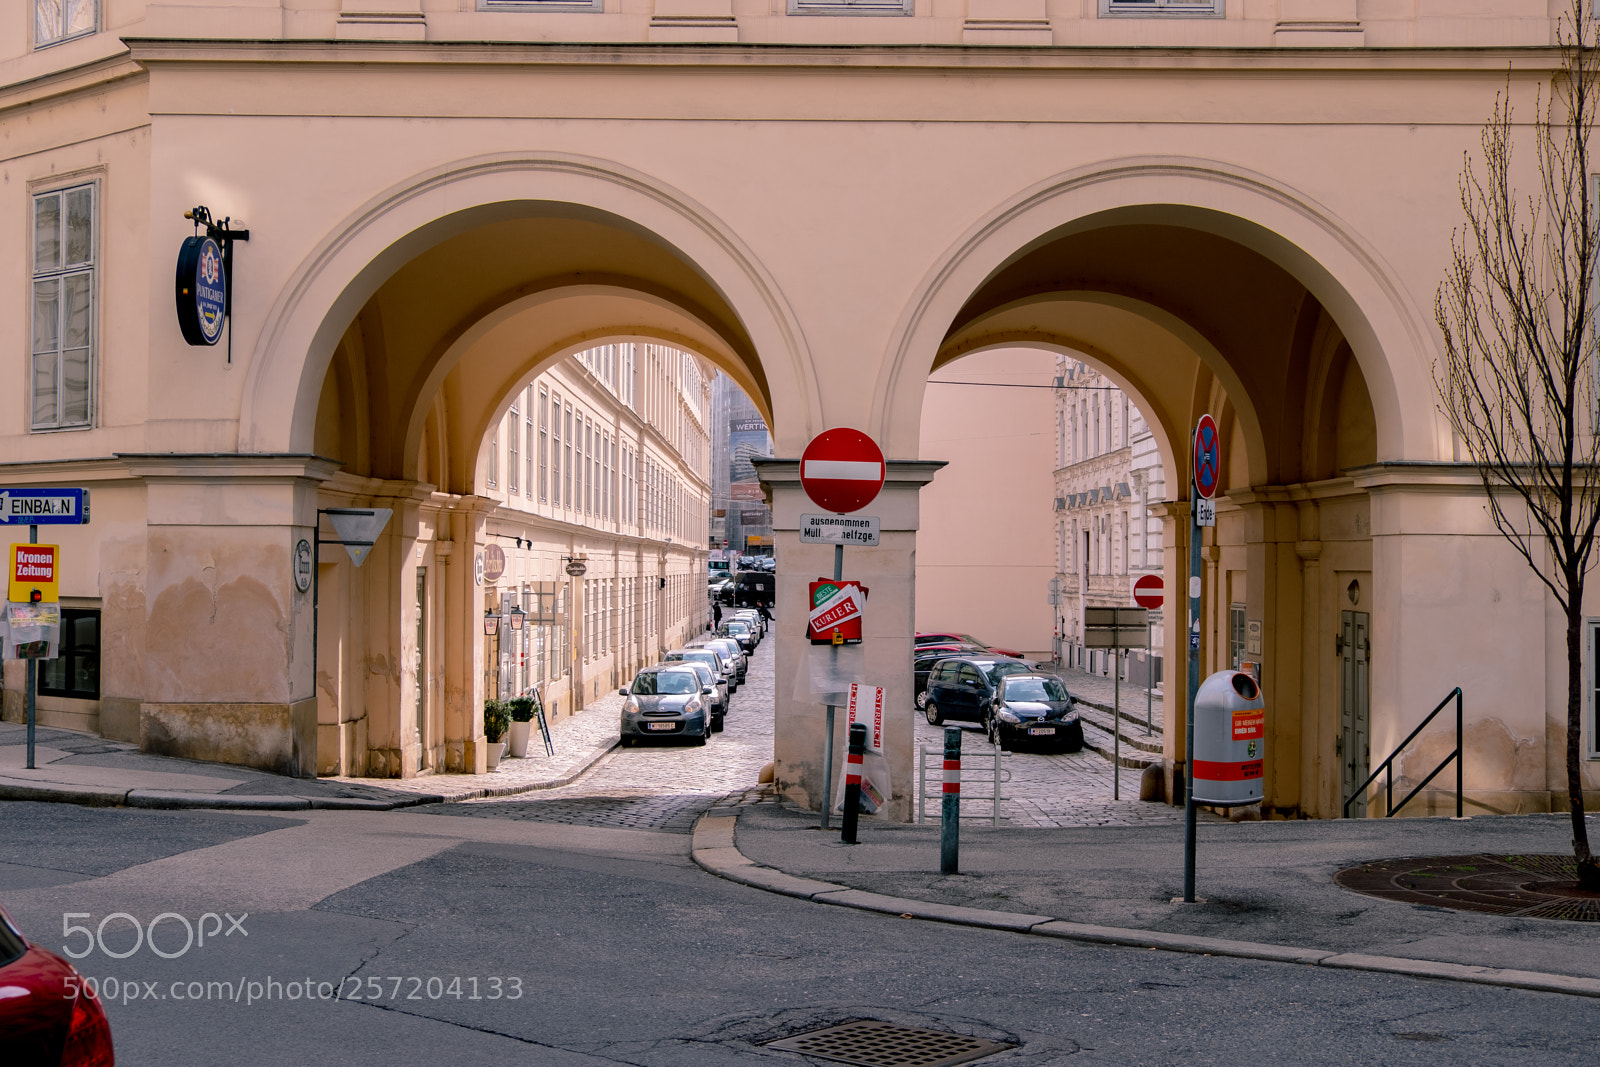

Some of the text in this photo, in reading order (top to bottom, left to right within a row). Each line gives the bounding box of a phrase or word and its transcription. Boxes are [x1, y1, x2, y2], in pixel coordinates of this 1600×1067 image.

[17, 551, 53, 564] Kronen
[17, 564, 53, 578] Zeitung
[816, 586, 833, 600] BESTE
[814, 602, 856, 628] KURIER
